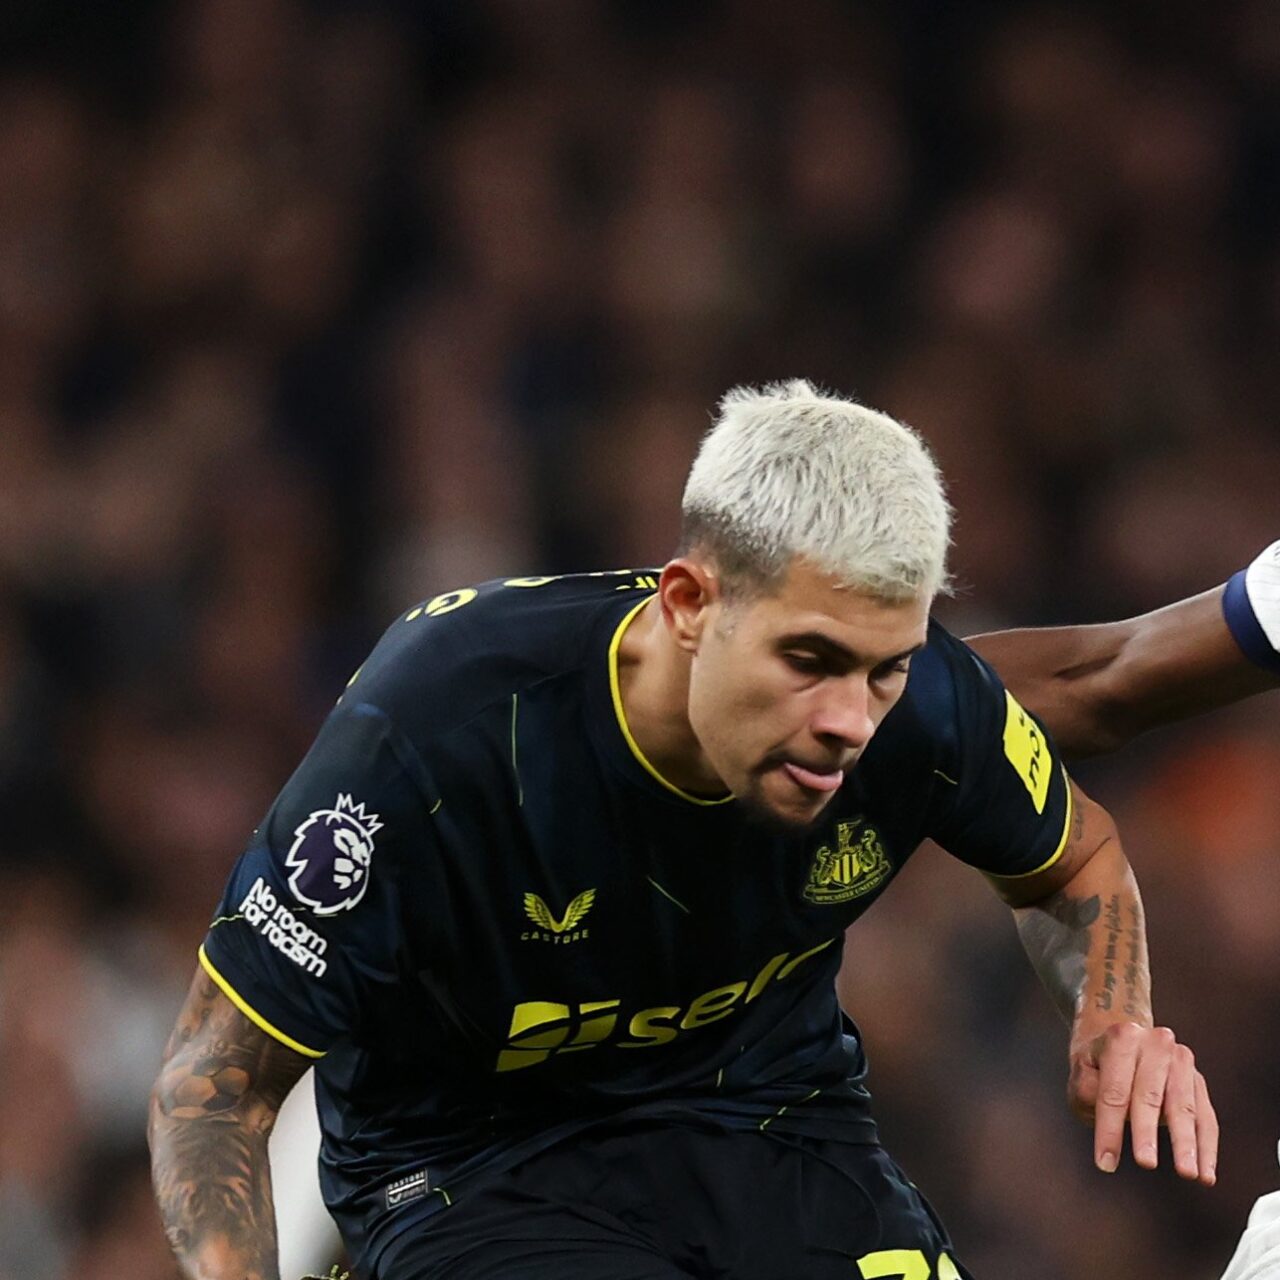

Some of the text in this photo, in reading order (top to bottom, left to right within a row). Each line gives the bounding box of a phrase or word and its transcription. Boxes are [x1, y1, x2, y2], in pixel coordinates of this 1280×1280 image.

[238, 895, 328, 978] for racism
[248, 876, 328, 956] No room
[520, 929, 590, 945] CASTORE
[615, 937, 837, 1049] sel
